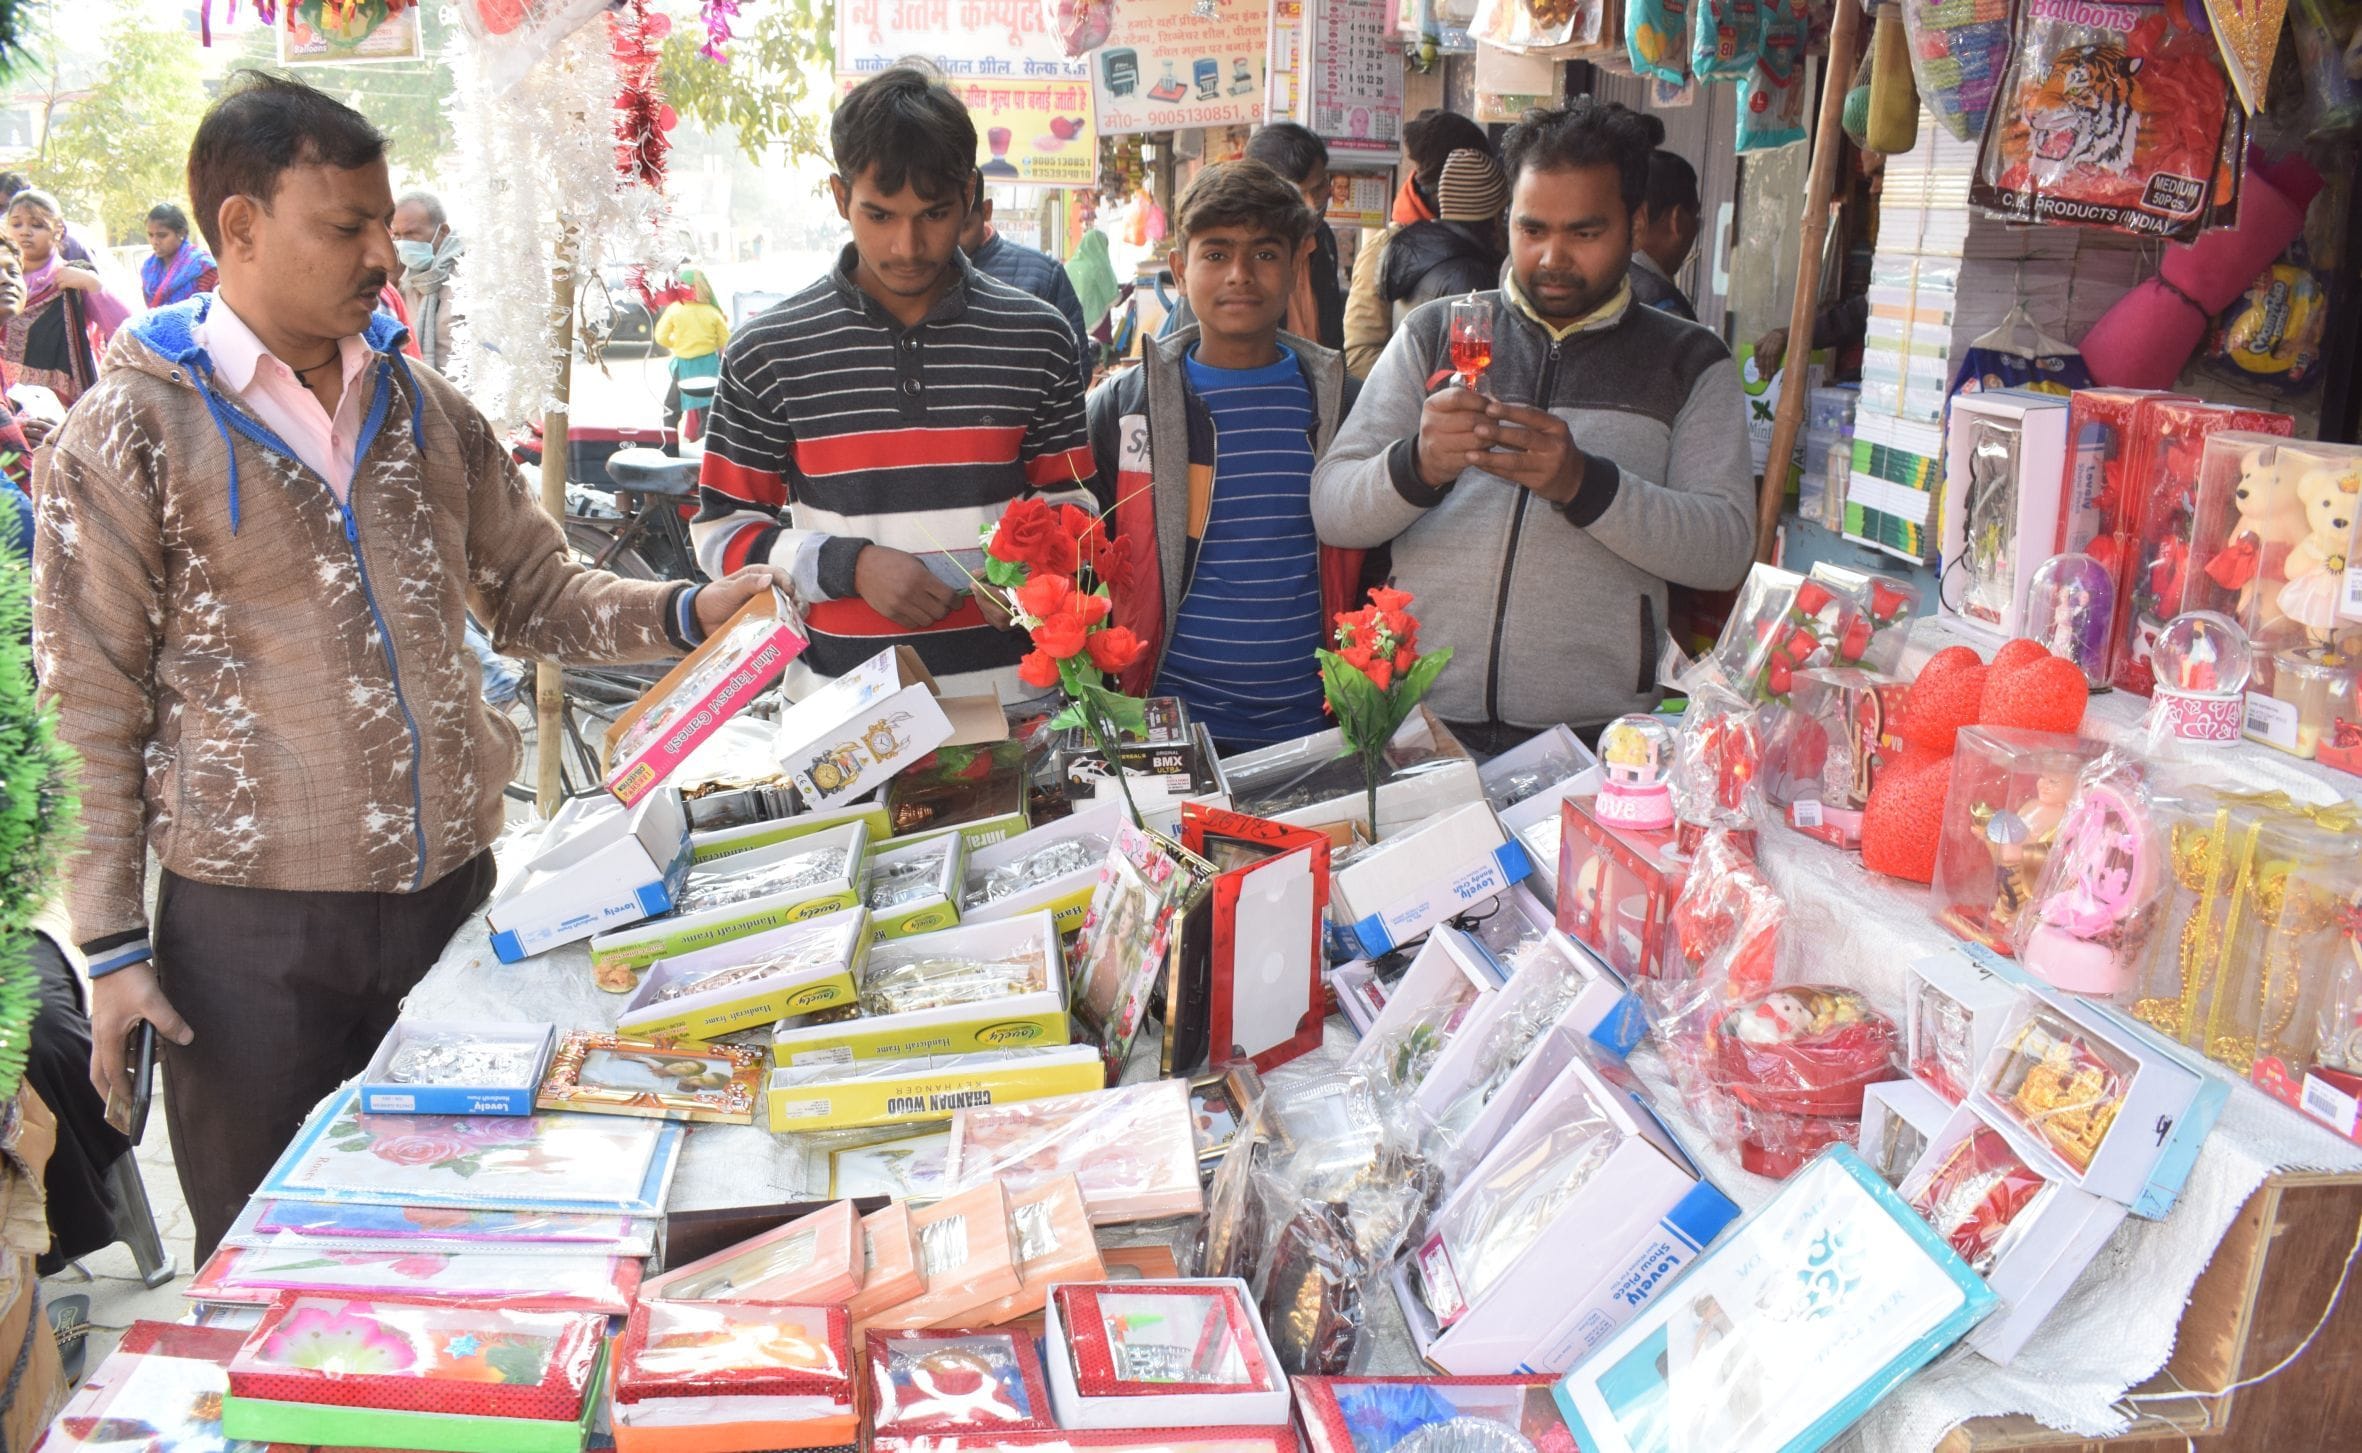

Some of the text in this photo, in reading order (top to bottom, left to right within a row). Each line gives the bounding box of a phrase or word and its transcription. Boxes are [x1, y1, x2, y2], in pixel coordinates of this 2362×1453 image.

[2154, 176, 2200, 198] MEDIUM
[2034, 194, 2118, 222] PRODUCTS
[2120, 208, 2169, 234] (INDIA)
[664, 645, 780, 755] Mini Tapasvi Ganesh
[1153, 756, 1183, 768] BMX
[1460, 877, 1495, 899] Lovely
[718, 915, 777, 938] Handicraft
[887, 1090, 991, 1115] CHANDAN WOOD
[1613, 1242, 1671, 1301] Show Piece
[1626, 1254, 1681, 1308] Lovely
